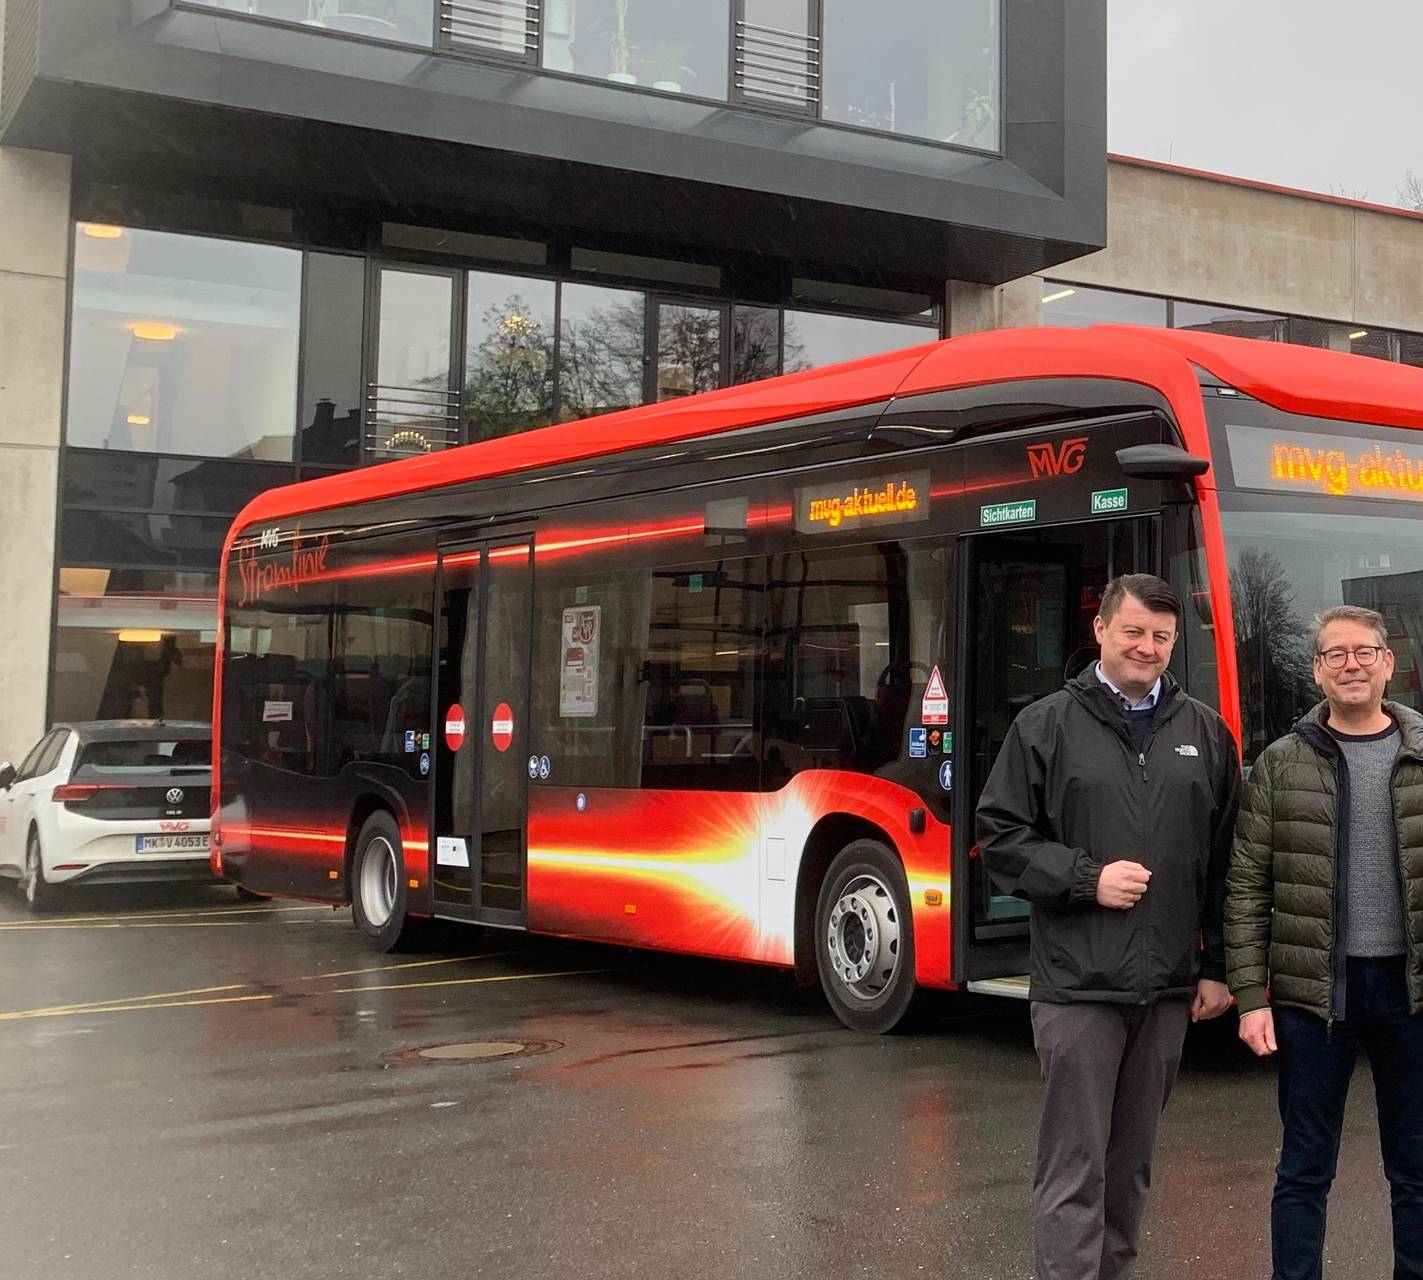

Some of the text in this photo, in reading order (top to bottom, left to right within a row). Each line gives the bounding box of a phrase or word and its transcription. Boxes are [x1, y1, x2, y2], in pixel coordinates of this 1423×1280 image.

[1027, 437, 1090, 479] MVG
[809, 481, 917, 527] mvg-aktuell.de
[1094, 494, 1124, 510] Kasse
[983, 505, 1033, 523] Sichtkarten
[260, 527, 280, 549] MVG
[144, 838, 158, 849] MK
